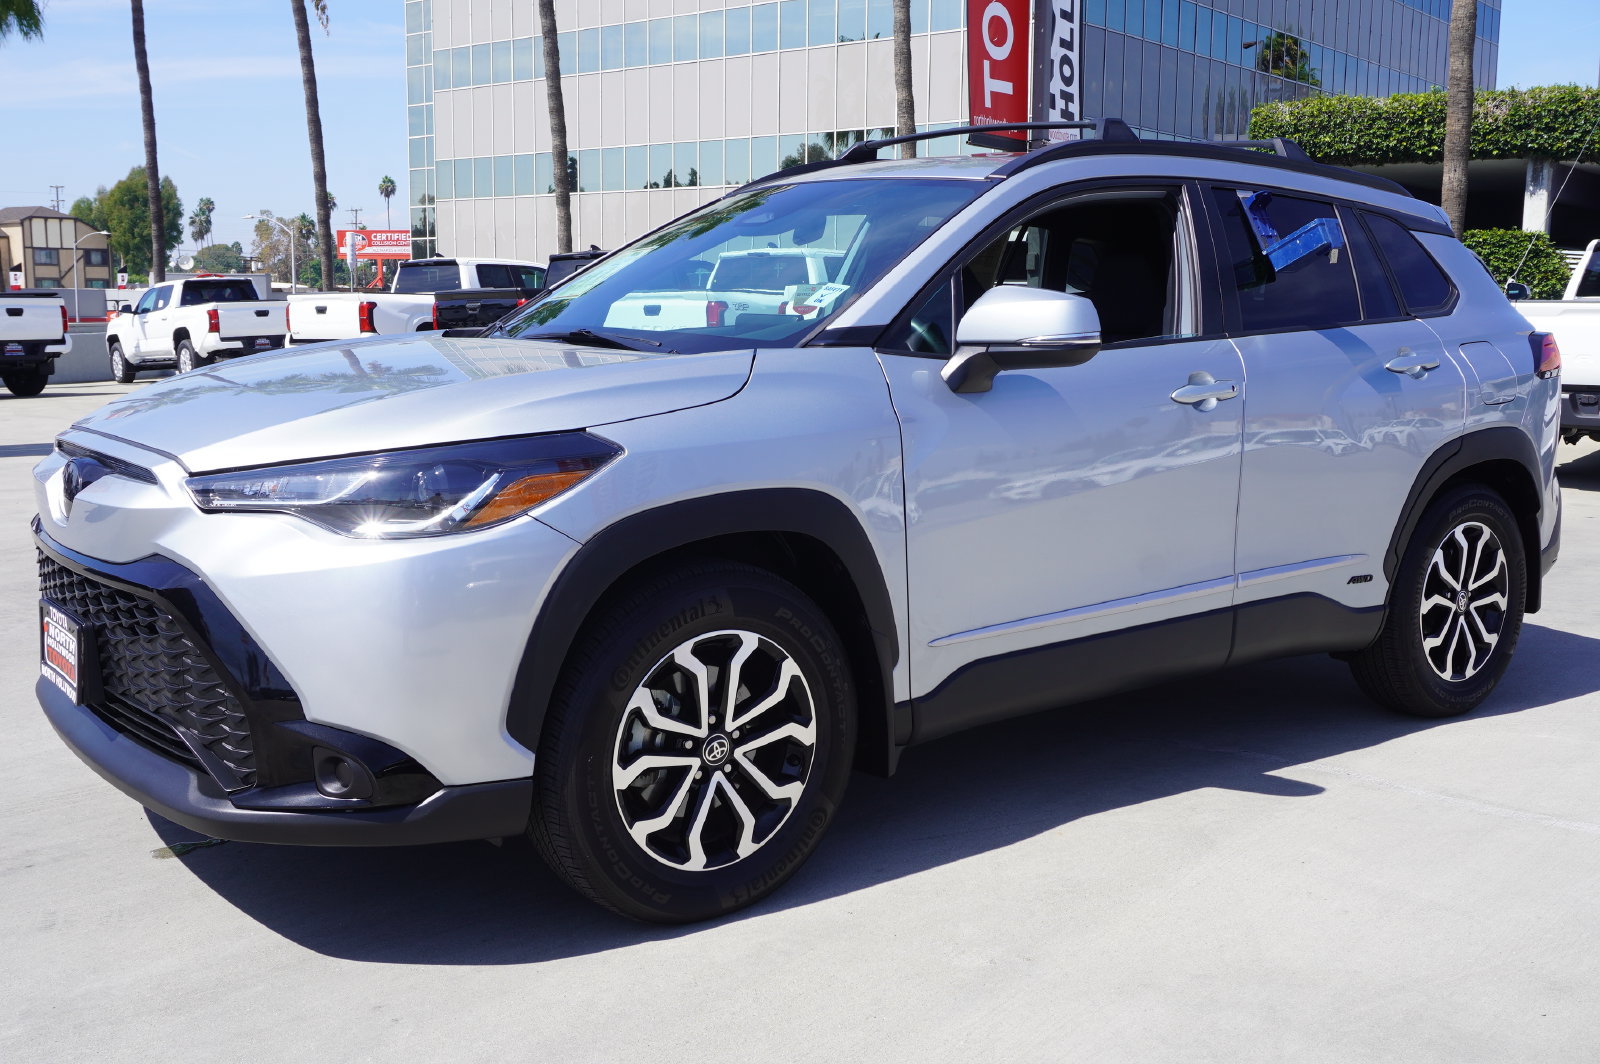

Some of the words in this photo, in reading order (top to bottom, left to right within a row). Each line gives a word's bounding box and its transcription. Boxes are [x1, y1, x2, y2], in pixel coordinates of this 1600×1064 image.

[982, 1, 1014, 108] TO
[49, 606, 68, 630] TOYOTA
[48, 623, 76, 655] NORTH
[41, 664, 56, 683] NORTH
[47, 647, 76, 680] TOYOTA
